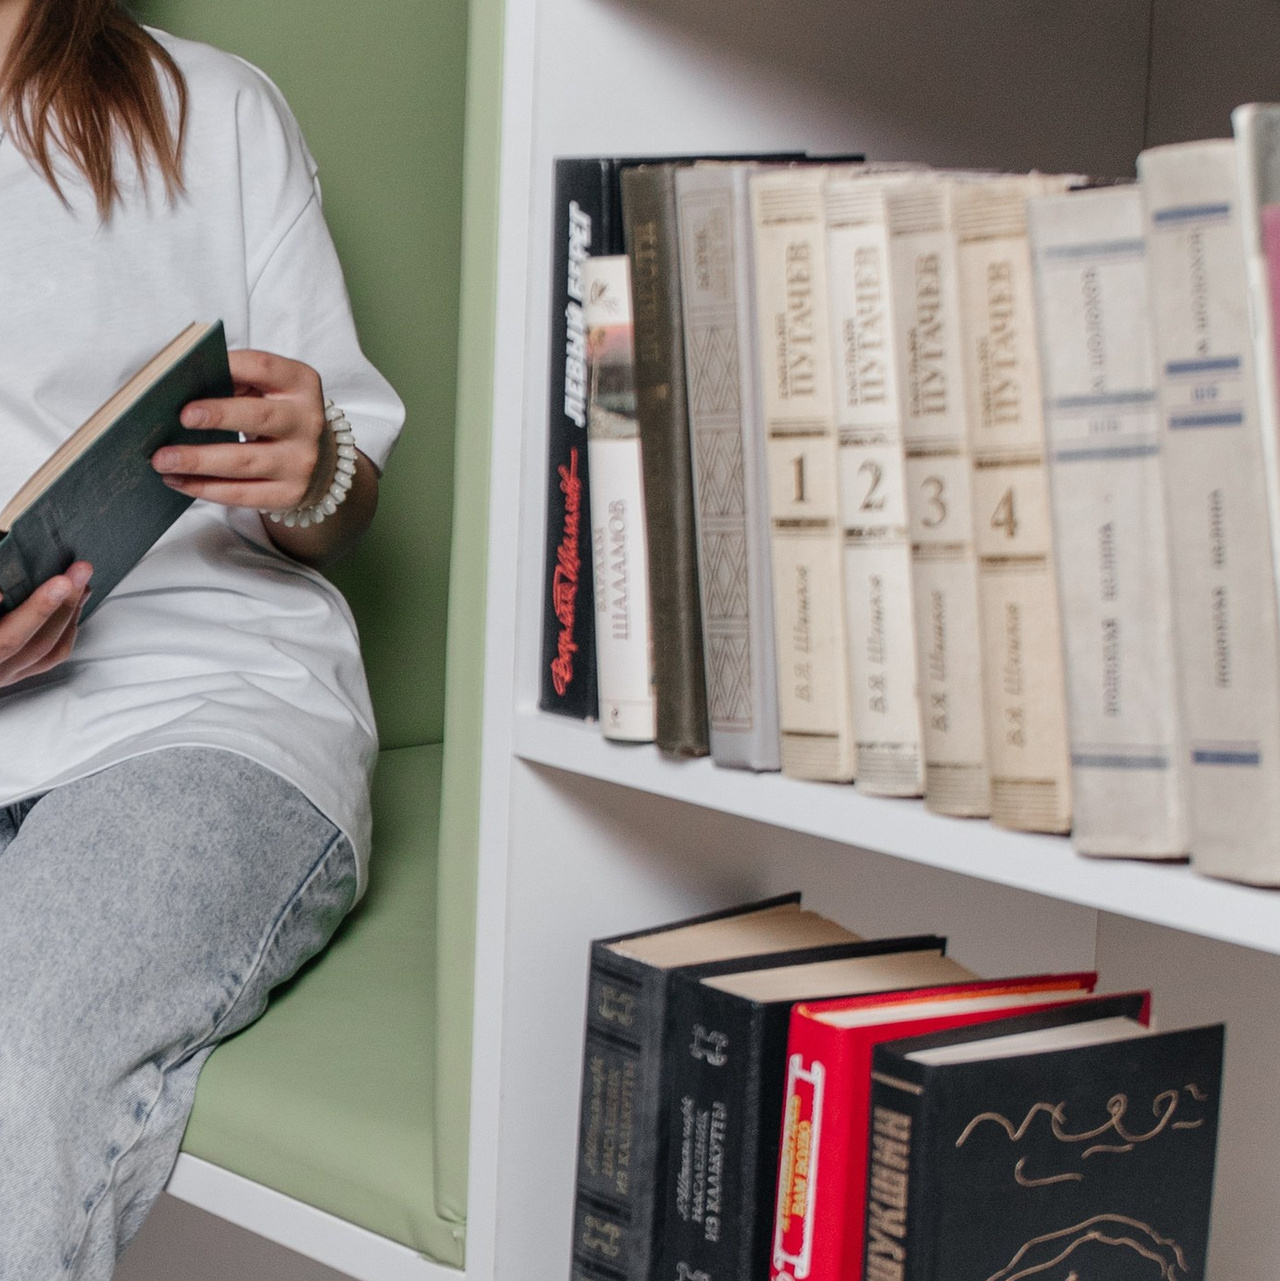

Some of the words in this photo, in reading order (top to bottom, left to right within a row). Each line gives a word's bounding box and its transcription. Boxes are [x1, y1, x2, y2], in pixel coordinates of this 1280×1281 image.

[566, 198, 593, 308] БЕРЕГ
[563, 300, 588, 429] ЛЕВЫЙ
[784, 241, 816, 397] ПУГАЧЕВ
[854, 245, 886, 406] ПУГАЧЕВ
[914, 253, 947, 415] ПУГАЧЕВ
[986, 260, 1020, 425] ПУГАЧЕВ
[790, 451, 806, 504] 1
[857, 456, 886, 512] 2
[920, 475, 948, 530] 3
[989, 485, 1019, 540] 4
[608, 498, 629, 641] ШАЛАМОВ
